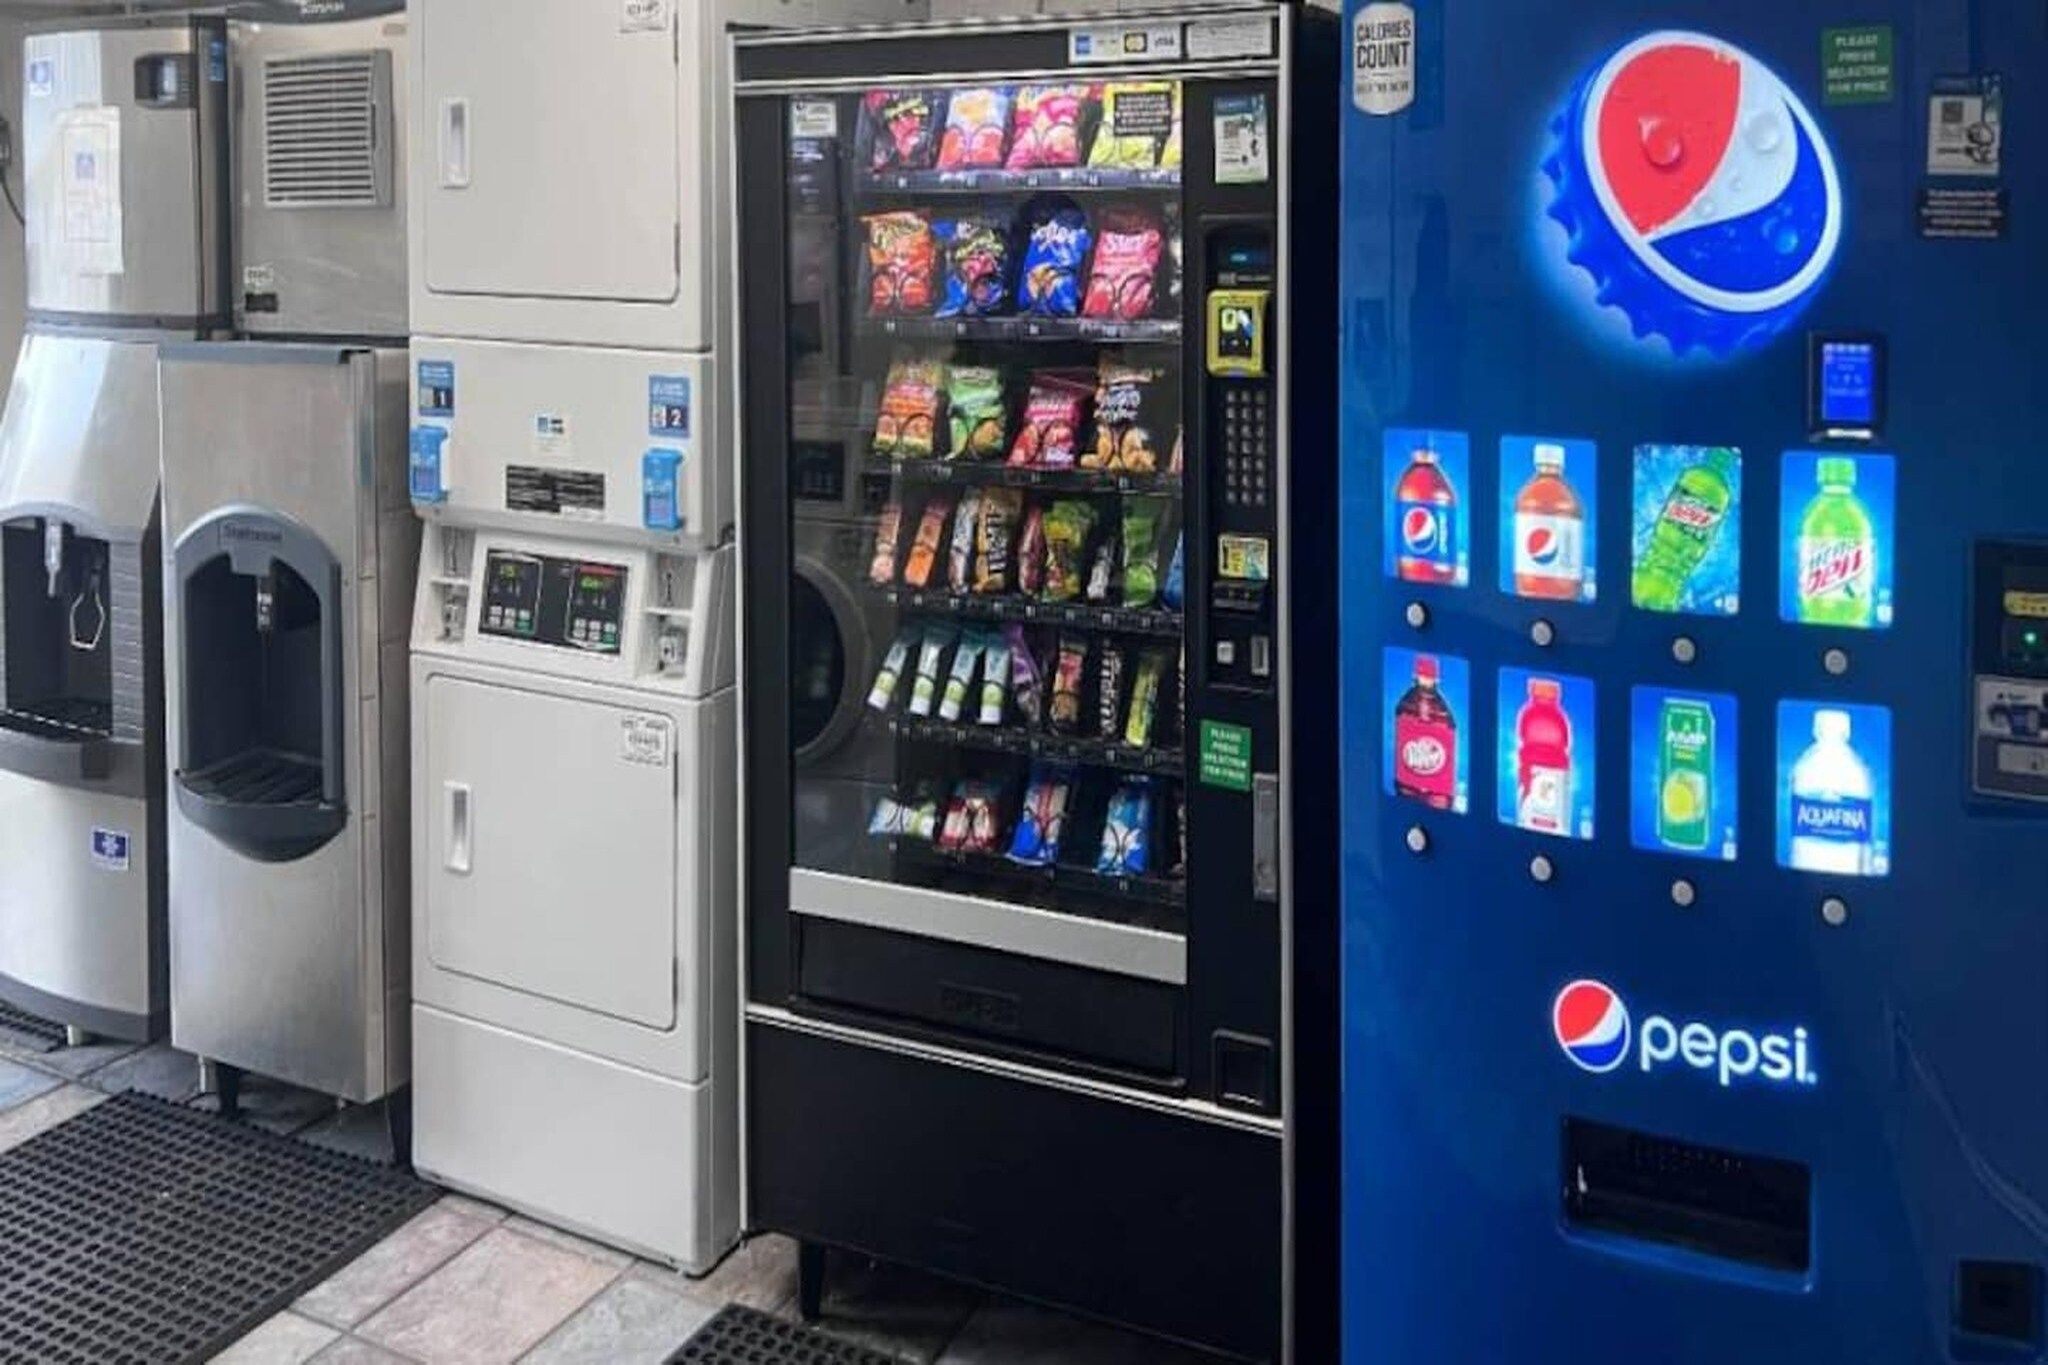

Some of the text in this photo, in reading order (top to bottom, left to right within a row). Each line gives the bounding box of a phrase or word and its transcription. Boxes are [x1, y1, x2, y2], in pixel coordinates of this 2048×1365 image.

[1357, 41, 1411, 68] COUNT
[1797, 803, 1867, 831] AQUAFINA
[1640, 1015, 1808, 1086] pepsi
